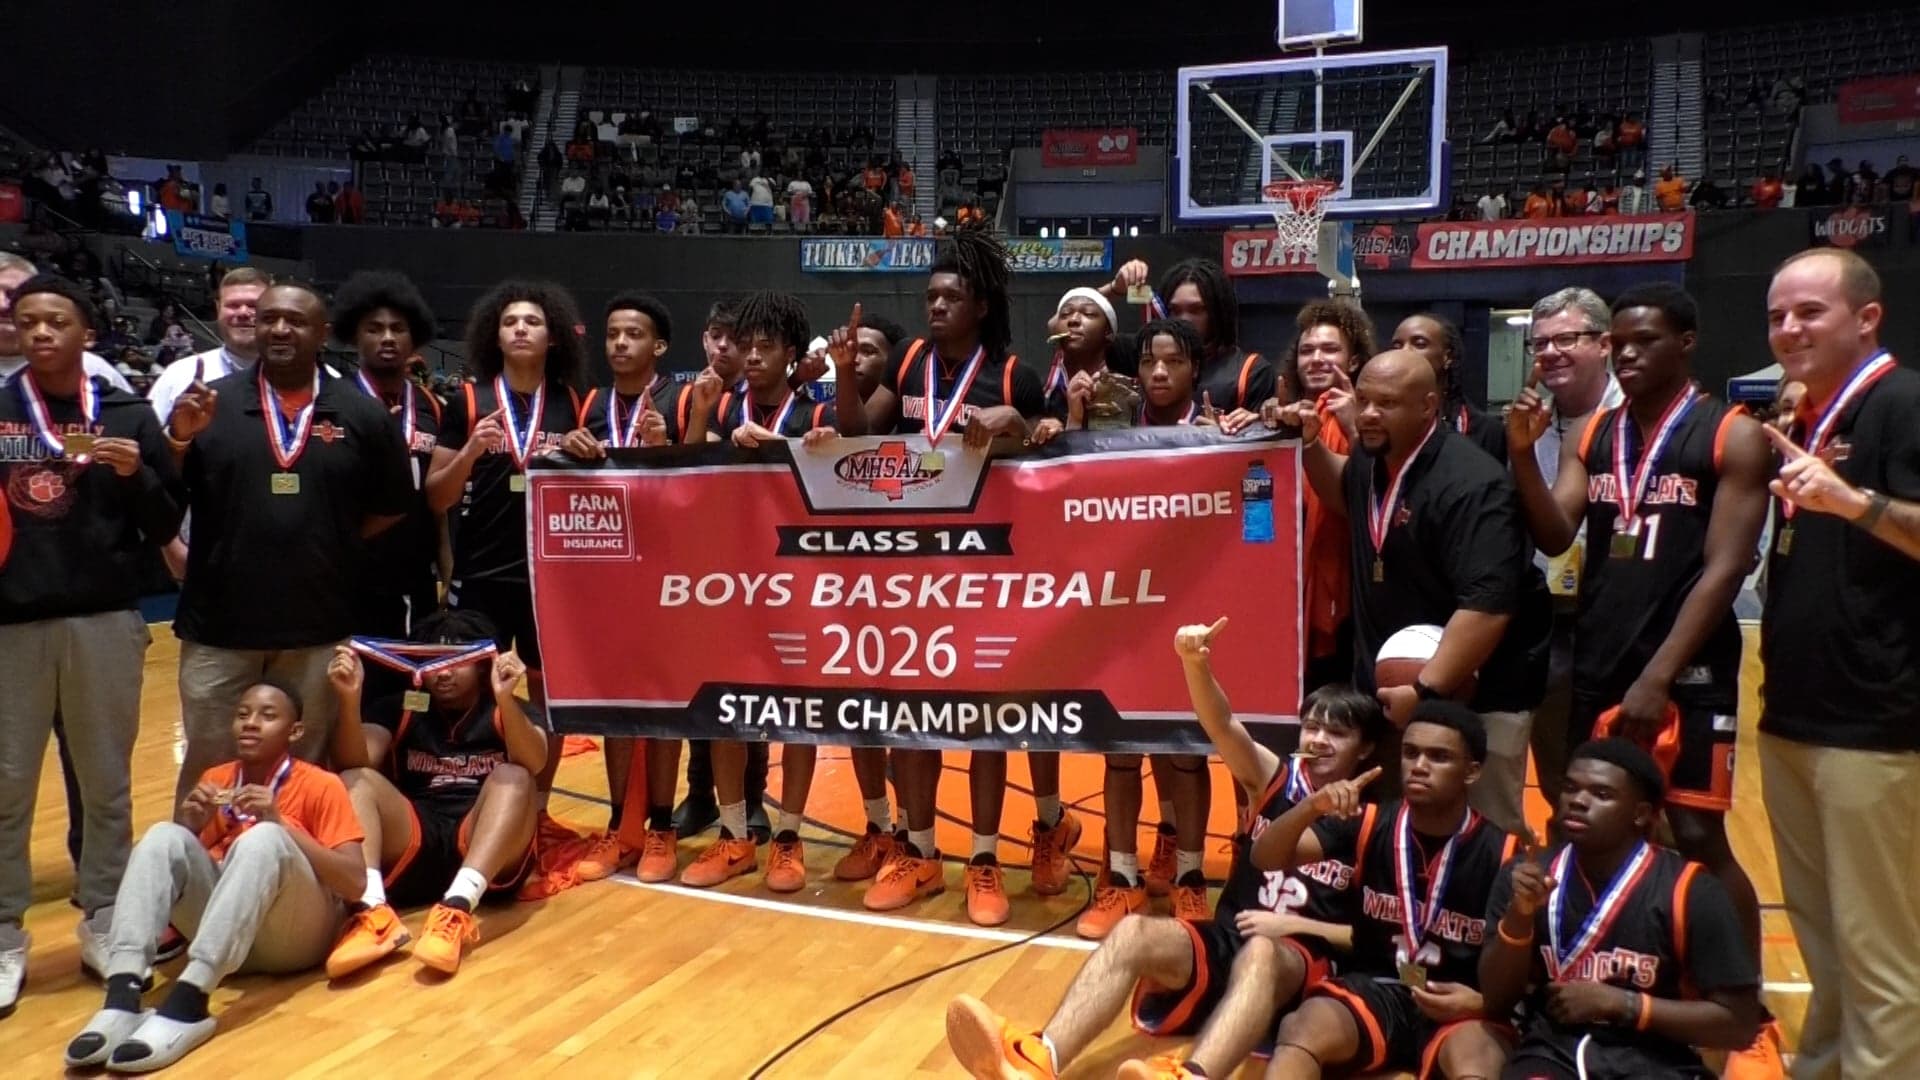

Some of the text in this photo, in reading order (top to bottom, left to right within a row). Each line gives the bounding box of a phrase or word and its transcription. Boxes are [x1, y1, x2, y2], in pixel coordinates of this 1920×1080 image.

[804, 242, 933, 267] TURKEY LEGS
[1428, 221, 1685, 261] CHAMPIONSHIPS
[570, 494, 619, 512] FARM
[1064, 491, 1233, 522] POWERADE
[549, 513, 622, 532] BUREAU
[563, 538, 624, 549] INSURANCE
[798, 530, 987, 552] CLASS 1A
[660, 569, 1167, 609] BOYS BASKETBALL
[820, 624, 957, 678] 2026
[718, 693, 1083, 734] STATE CHAMPIONS
[1258, 869, 1308, 913] 32
